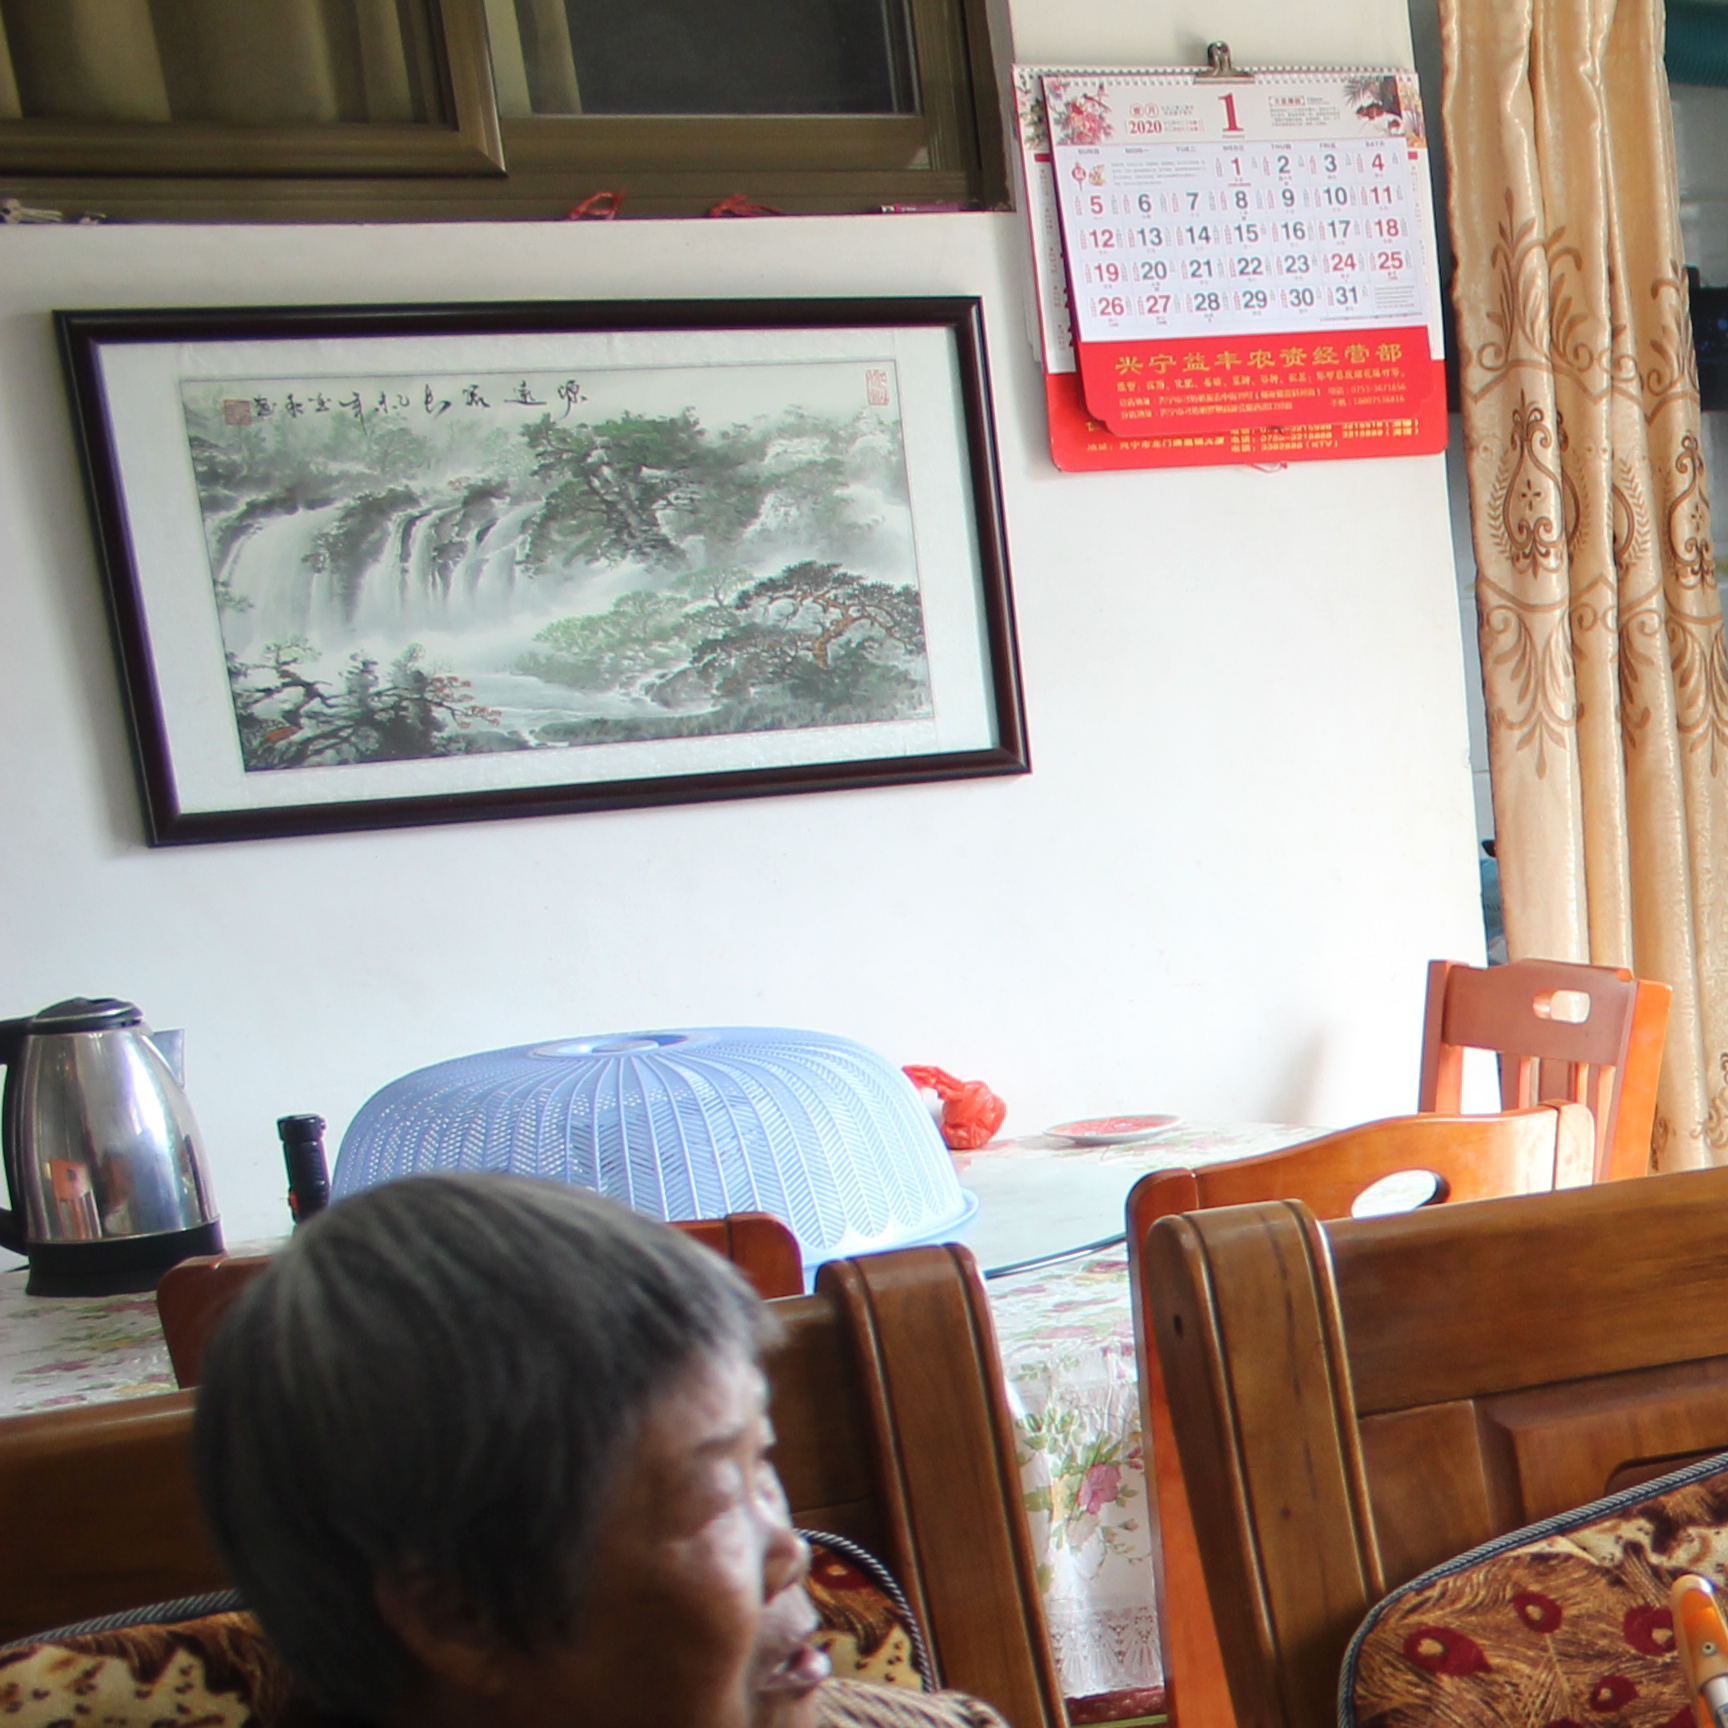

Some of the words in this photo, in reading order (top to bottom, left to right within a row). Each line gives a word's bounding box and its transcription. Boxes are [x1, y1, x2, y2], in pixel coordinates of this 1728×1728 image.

[1129, 120, 1162, 134] 2020
[1218, 92, 1244, 132] 1
[1232, 157, 1240, 175] 1
[1277, 155, 1290, 174] 2
[1324, 154, 1337, 172] 3
[1372, 153, 1384, 171] 4
[1090, 196, 1103, 214] 5
[1138, 194, 1152, 212] 6
[1186, 192, 1199, 210] 7
[1235, 190, 1248, 209] 8
[1282, 188, 1295, 207] 9
[1324, 187, 1347, 205] 10
[1370, 186, 1392, 204] 11
[1089, 229, 1114, 248] 12
[1137, 227, 1163, 246] 13
[1186, 226, 1211, 244] 14
[1235, 224, 1259, 242] 15
[1281, 222, 1305, 240] 16
[1328, 220, 1351, 238] 17
[1375, 218, 1399, 237] 18
[1094, 263, 1119, 282] 19
[1141, 261, 1167, 280] 20
[1189, 259, 1213, 278] 21
[1237, 257, 1263, 275] 22
[1285, 255, 1310, 273] 23
[1331, 253, 1356, 271] 24
[1378, 251, 1403, 270] 25
[1098, 297, 1124, 316] 26
[1146, 295, 1171, 314] 27
[1194, 293, 1220, 311] 28
[1242, 290, 1267, 309] 29
[1289, 288, 1314, 306] 30
[1336, 286, 1358, 305] 31
[1115, 344, 1402, 375] 兴宁益丰农资经营部
